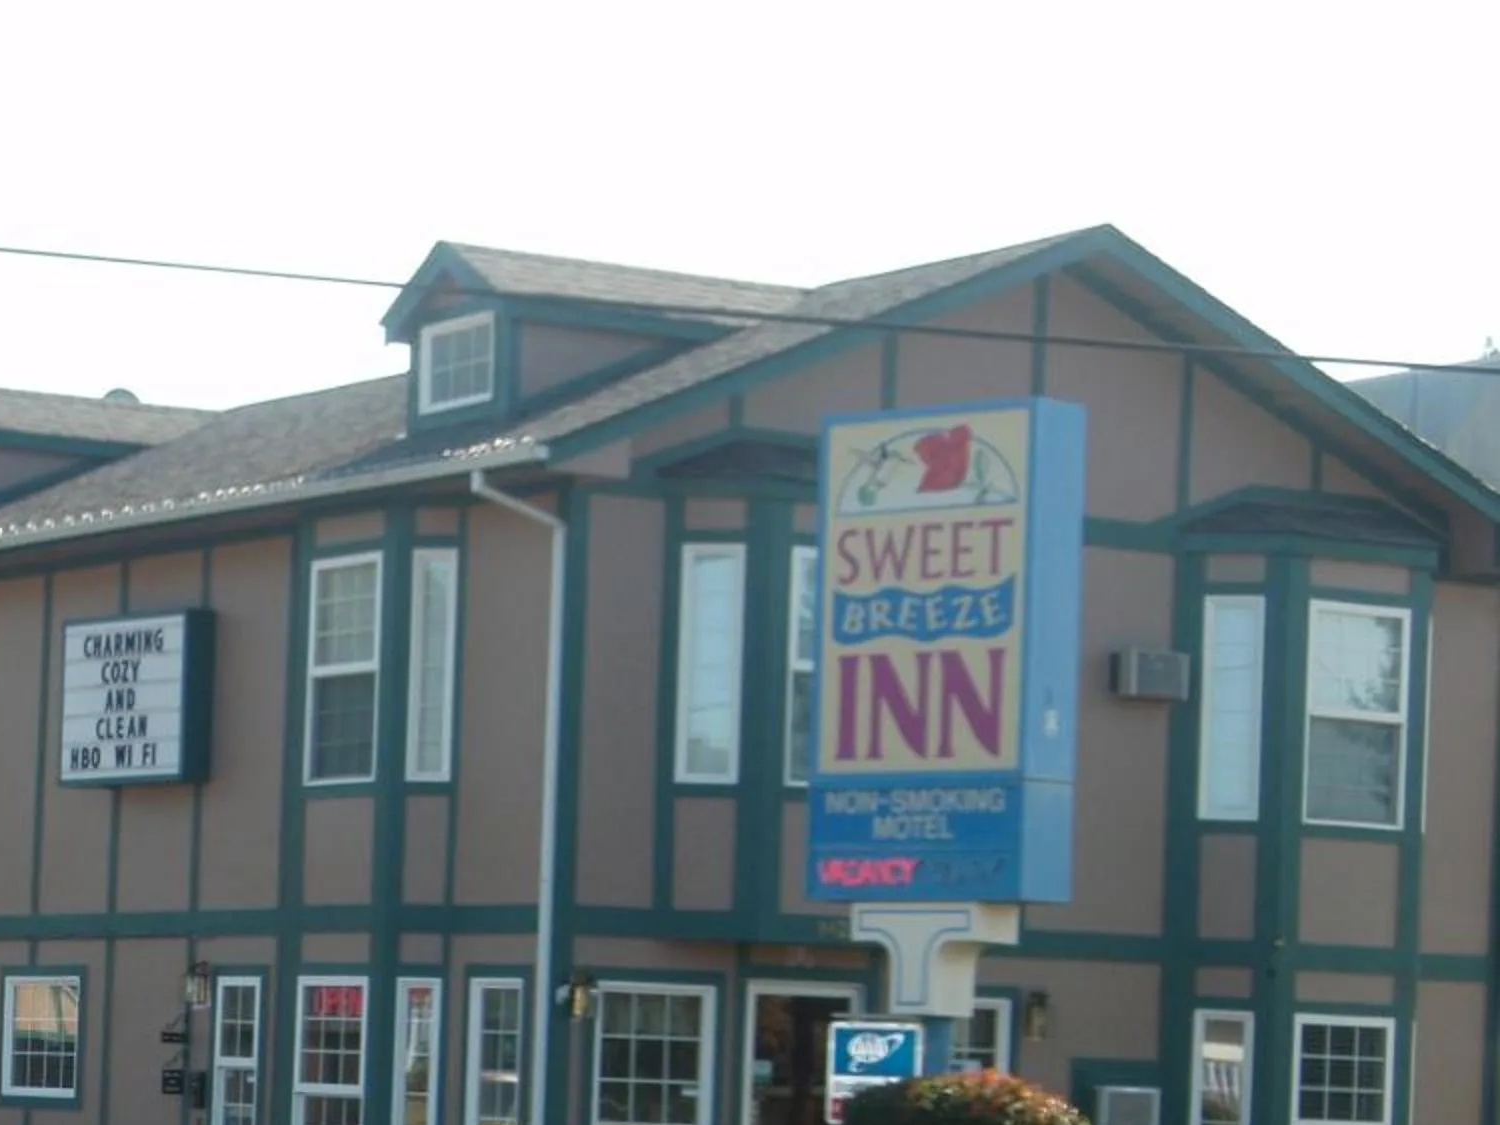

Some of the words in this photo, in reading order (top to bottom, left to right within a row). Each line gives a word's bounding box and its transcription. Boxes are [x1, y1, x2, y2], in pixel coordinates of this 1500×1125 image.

[835, 518, 1014, 586] SWEET
[840, 590, 1003, 635] BREEZE
[84, 628, 165, 659] CHARMING
[101, 659, 141, 685] COZY
[104, 688, 136, 714] AND
[833, 646, 1008, 761] INN
[95, 714, 148, 741] CLEAN
[70, 746, 101, 771] HBO
[114, 744, 133, 768] WI
[141, 743, 157, 767] FI
[824, 787, 1007, 815] NON-SMOKING
[871, 815, 956, 840] MOTEL
[817, 856, 920, 887] VACANCY
